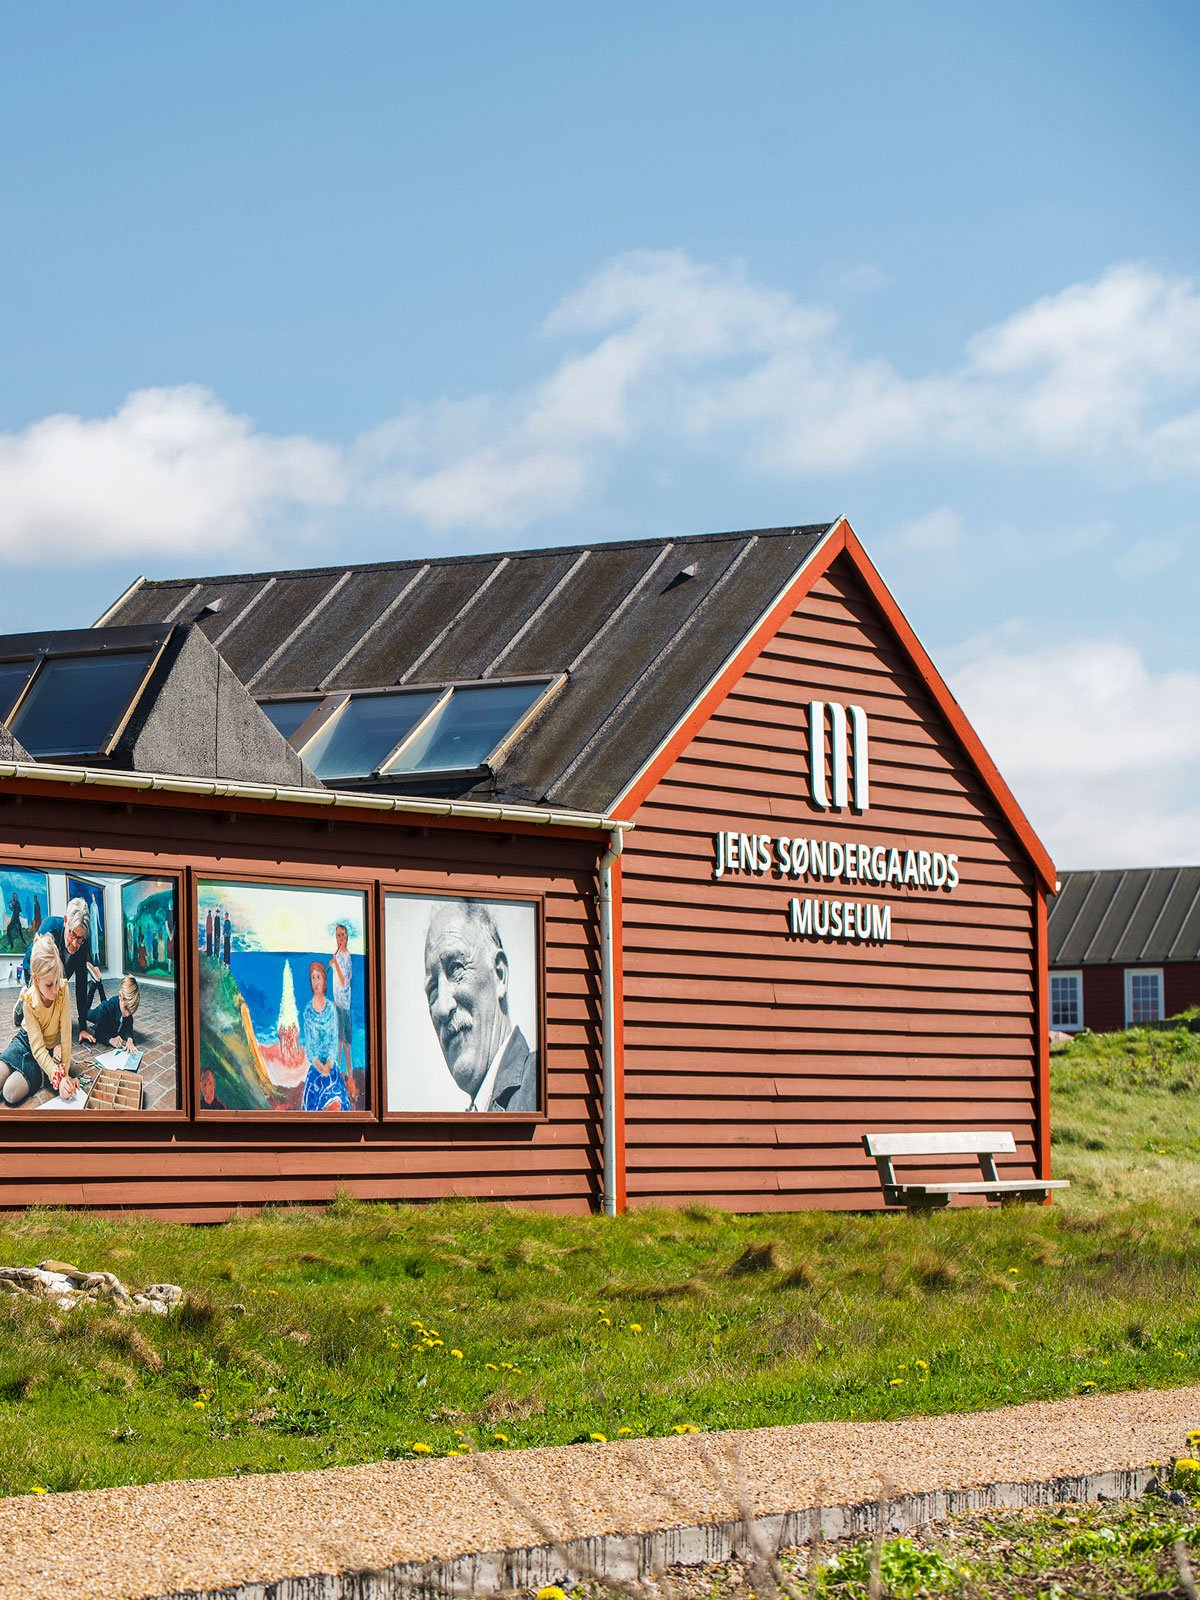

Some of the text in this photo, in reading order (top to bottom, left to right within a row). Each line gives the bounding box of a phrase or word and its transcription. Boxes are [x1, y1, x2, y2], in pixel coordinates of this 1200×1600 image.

[715, 831, 959, 889] JENS SØNDERGAARDS
[790, 898, 892, 941] MUSEUM
